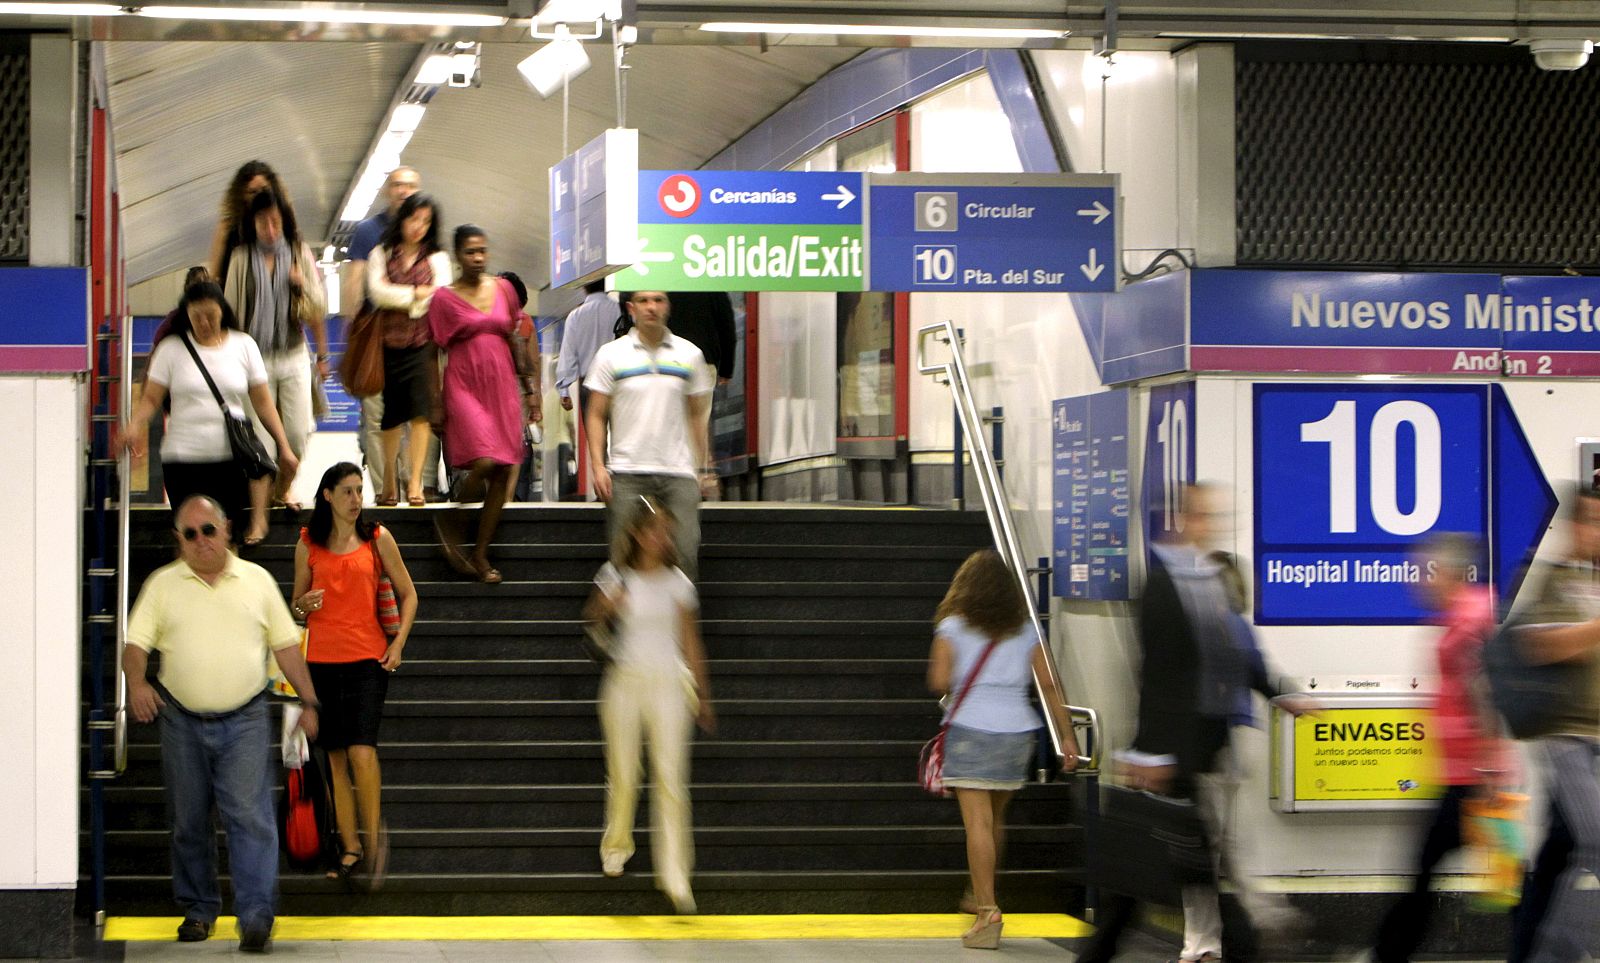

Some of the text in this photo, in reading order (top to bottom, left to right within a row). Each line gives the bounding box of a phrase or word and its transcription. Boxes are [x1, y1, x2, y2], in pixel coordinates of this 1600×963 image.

[709, 188, 797, 204] Cercanías
[925, 195, 1036, 228] 6 Circular
[682, 234, 863, 279] Salida/Exit
[915, 248, 1065, 285] 10 Pta. del Sur
[1291, 292, 1451, 330] Nuevos
[1452, 350, 1553, 375] Andén 2
[1157, 399, 1188, 534] 10
[1300, 399, 1442, 535] 10
[1266, 559, 1348, 588] Hospital
[1354, 559, 1420, 583] Infanta
[1314, 722, 1425, 742] ENVASES
[1315, 747, 1345, 756] Juntos
[1347, 747, 1392, 757] podemos
